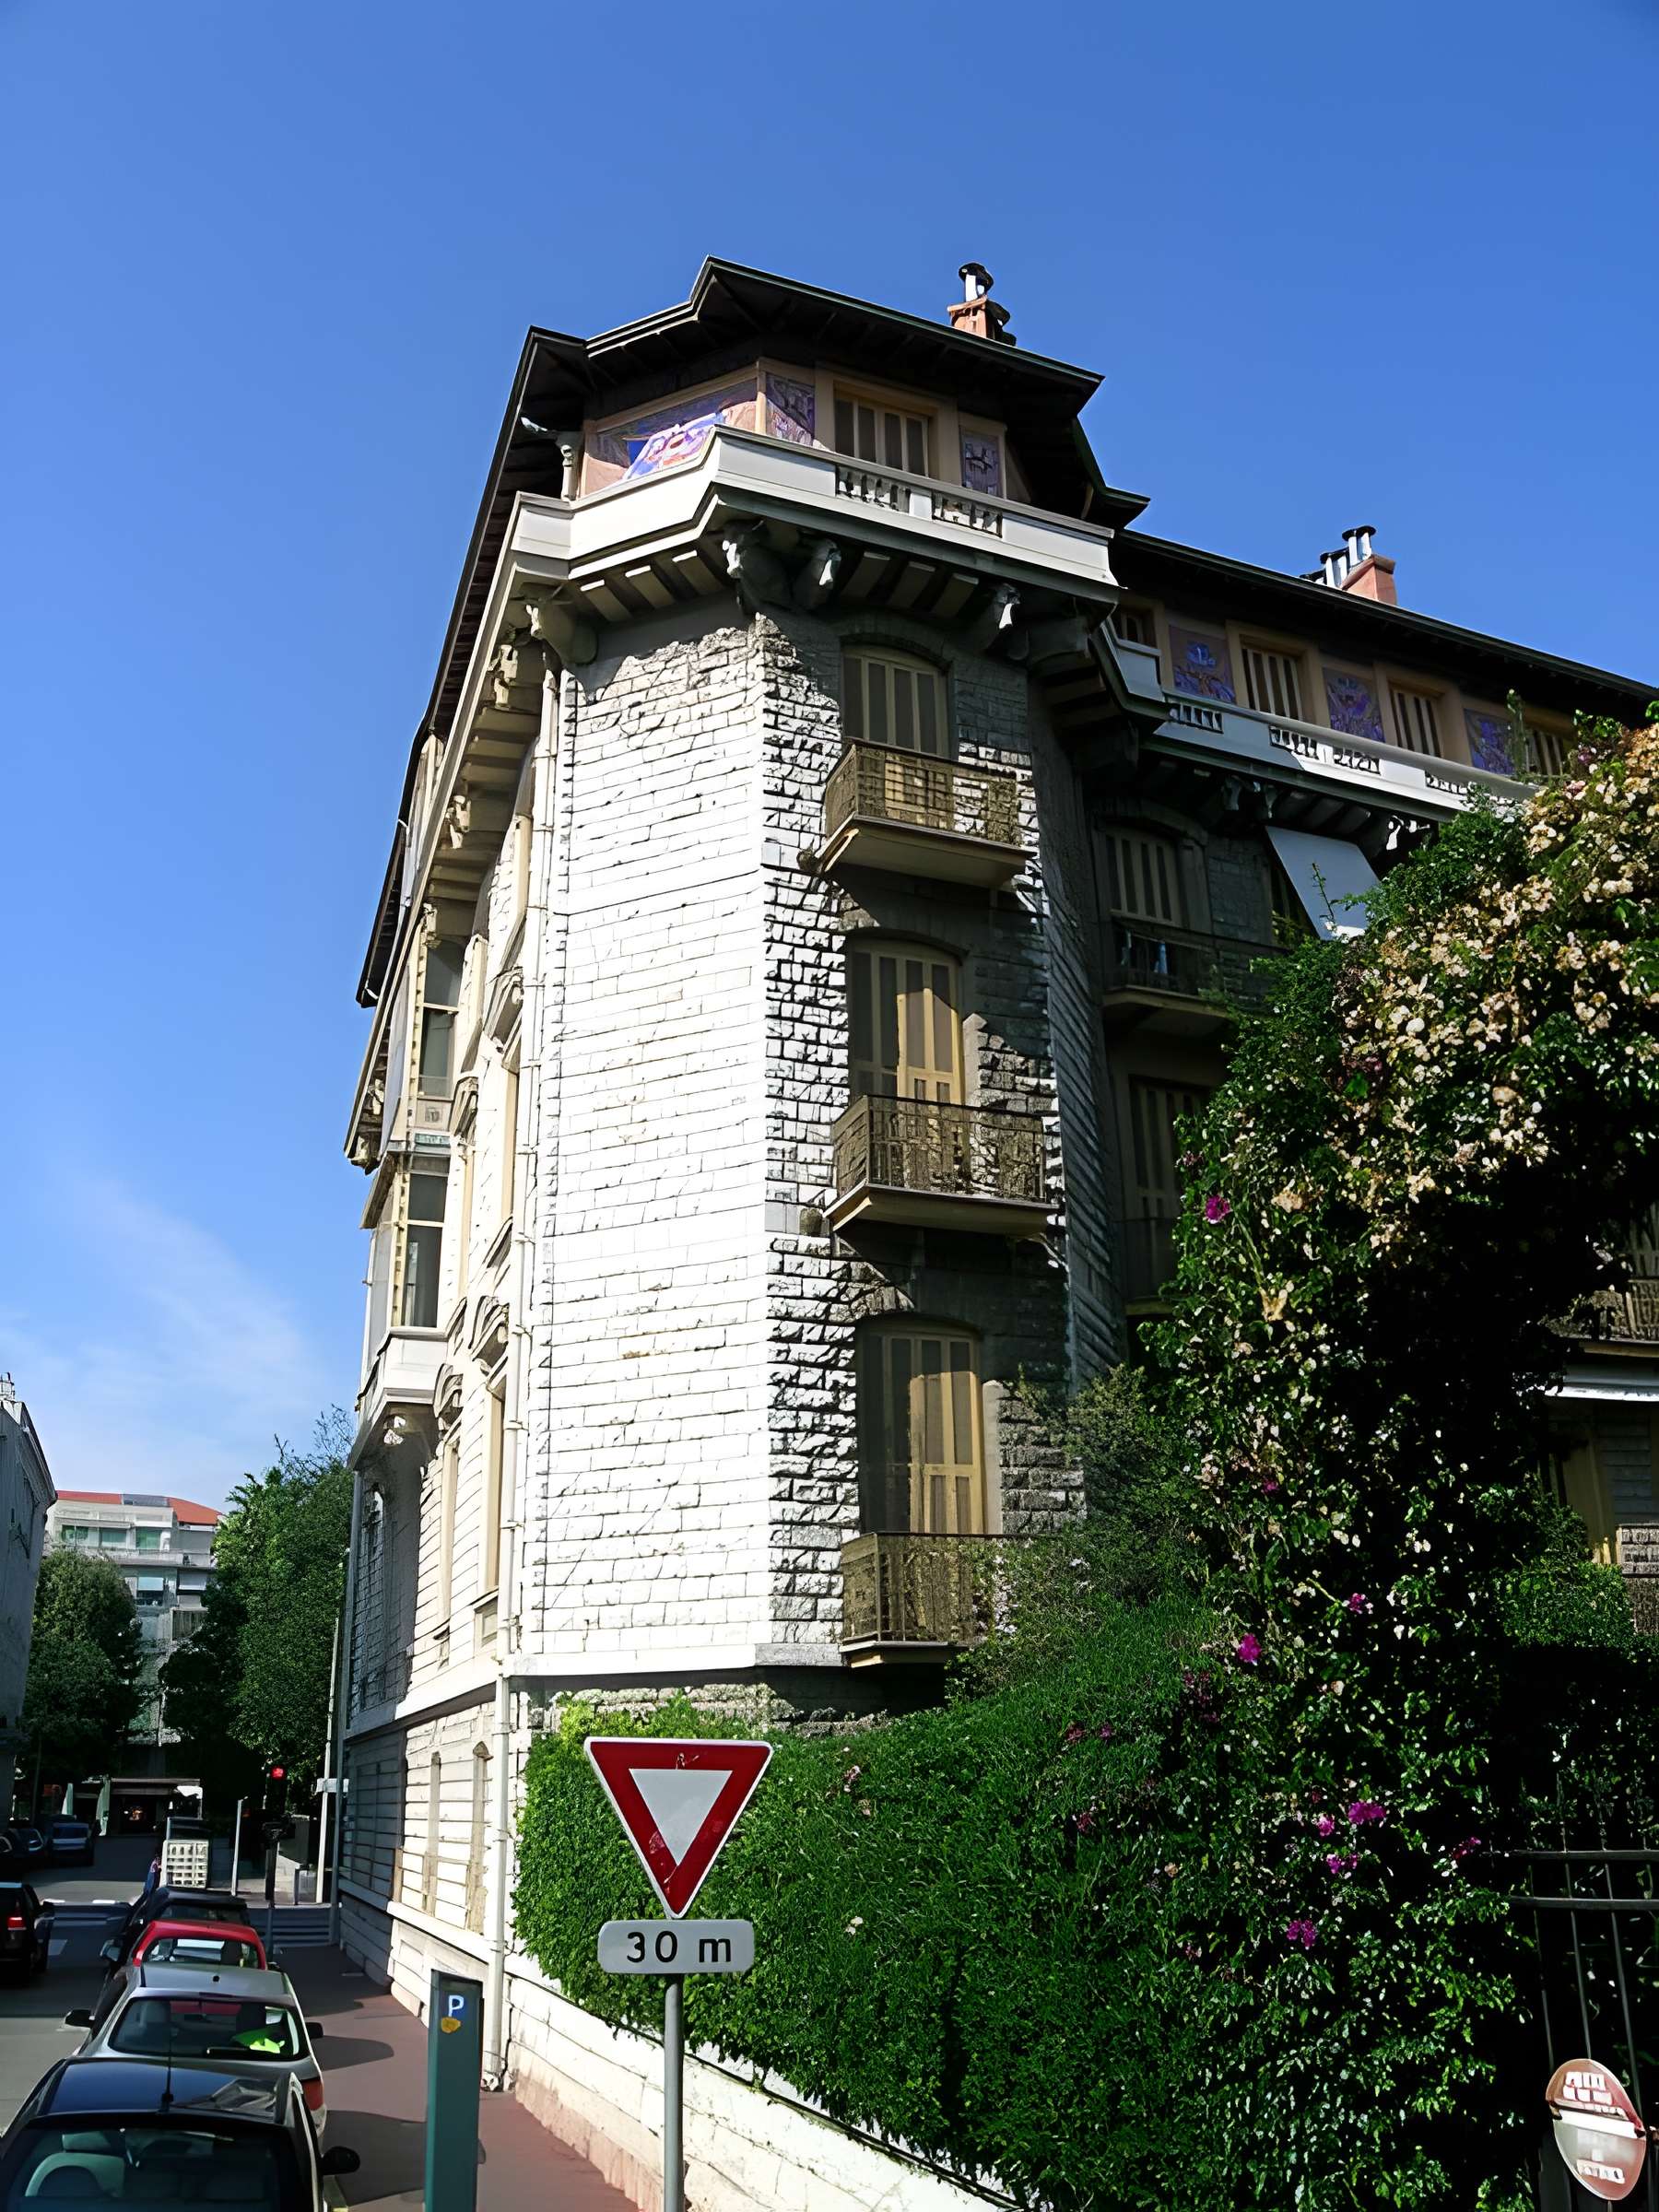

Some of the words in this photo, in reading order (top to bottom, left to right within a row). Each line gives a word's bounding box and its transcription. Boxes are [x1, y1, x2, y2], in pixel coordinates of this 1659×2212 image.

[627, 1931, 677, 1963] 30
[700, 1938, 731, 1963] m
[448, 1994, 465, 2018] P
